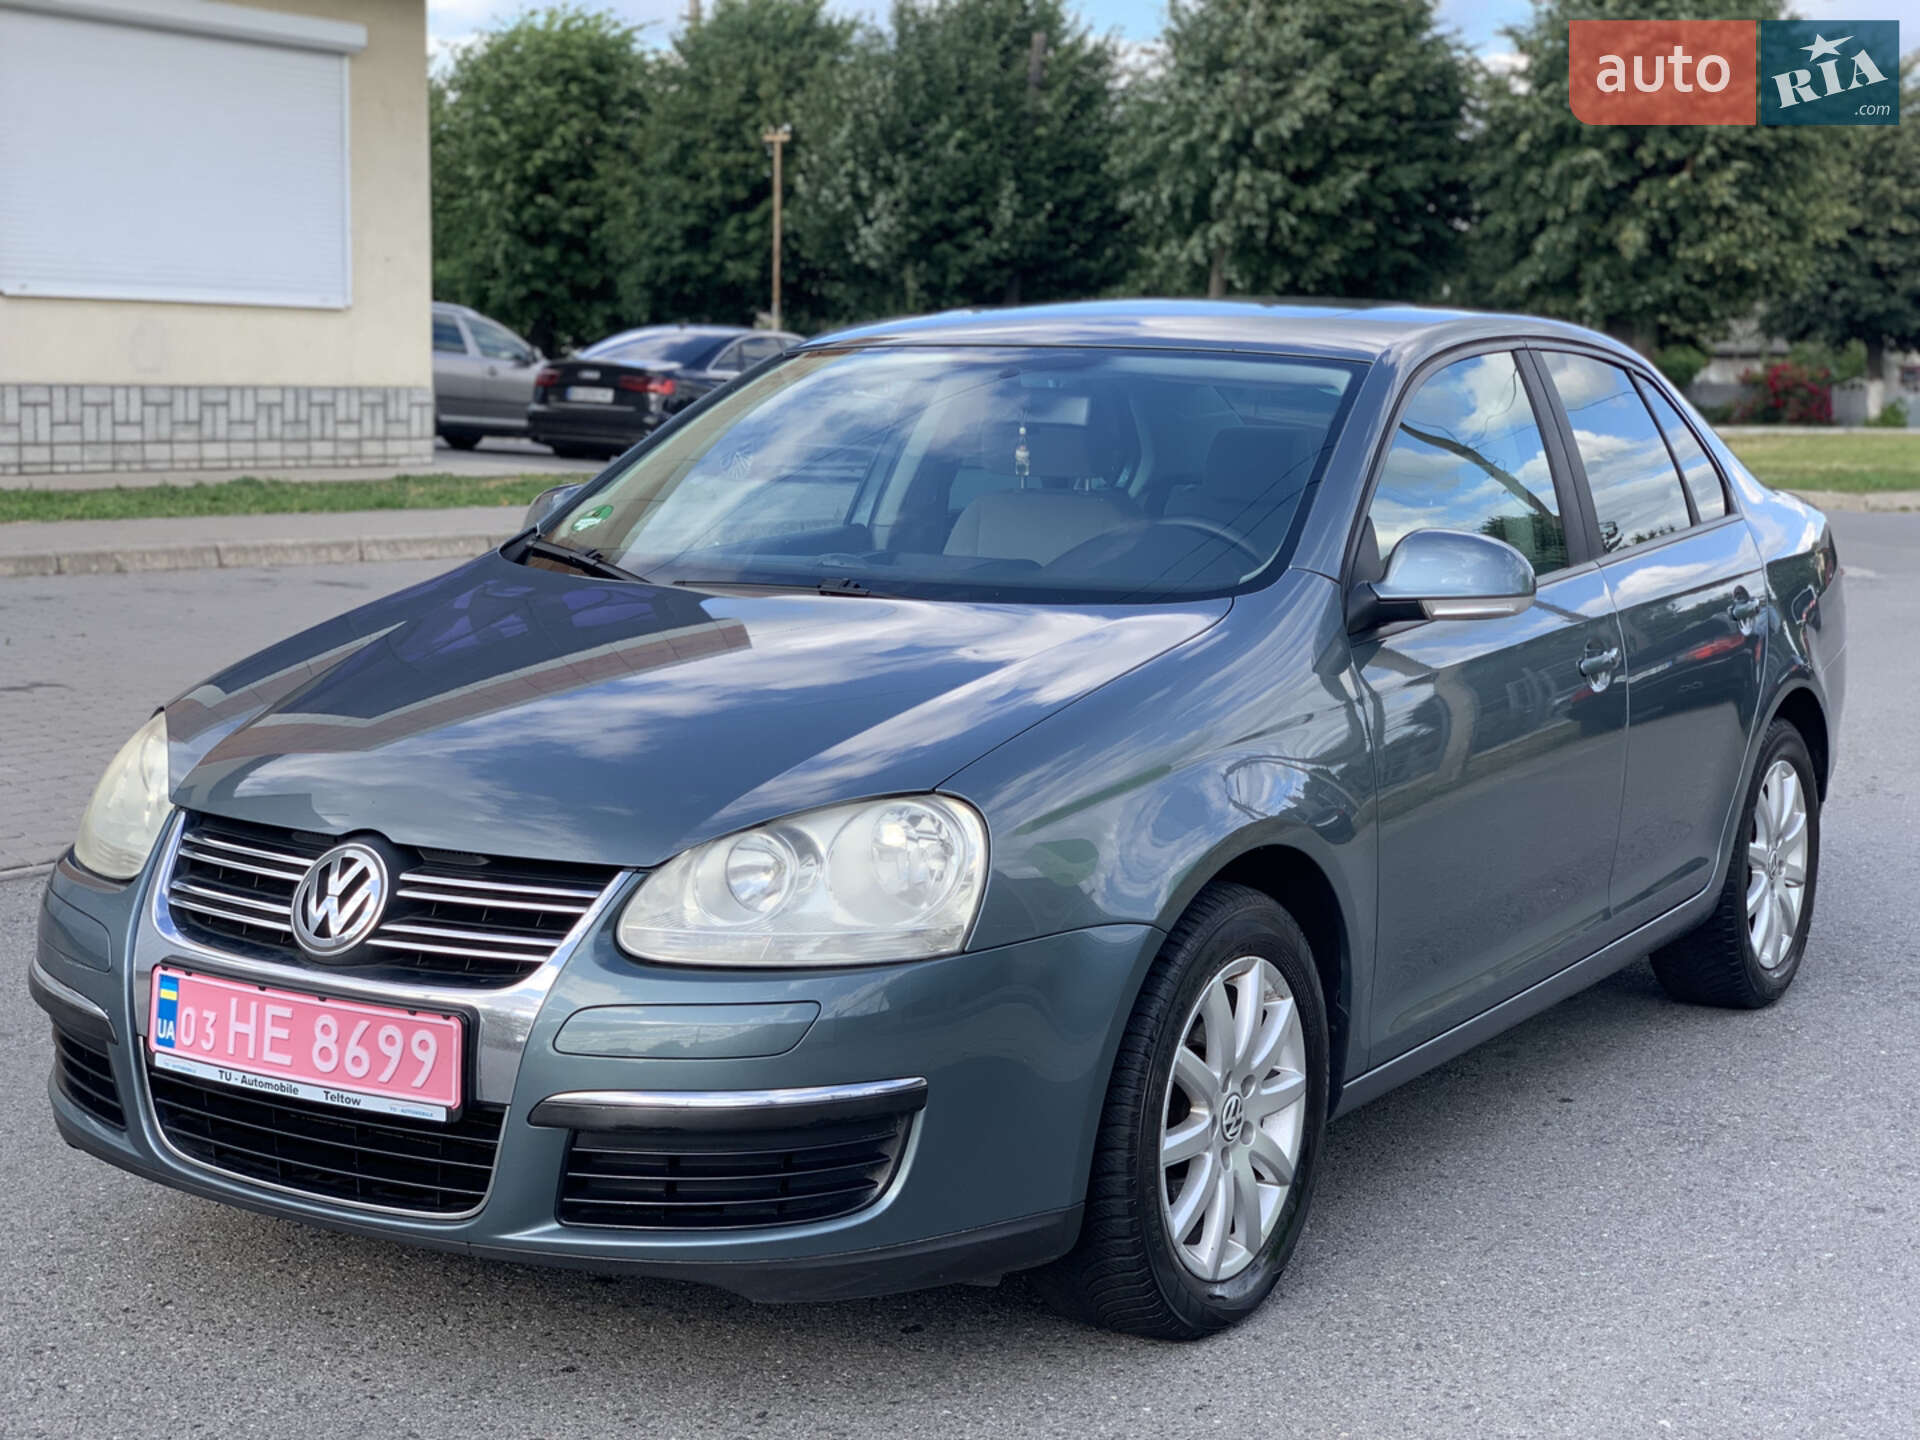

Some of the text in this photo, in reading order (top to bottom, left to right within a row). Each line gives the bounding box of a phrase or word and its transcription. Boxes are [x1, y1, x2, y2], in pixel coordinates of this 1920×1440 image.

[291, 843, 388, 956] VW
[157, 1018, 176, 1041] UA
[180, 997, 438, 1089] 03 HE 8699
[218, 1069, 233, 1082] TU
[240, 1075, 300, 1096] Automobile
[323, 1090, 362, 1107] Teltow
